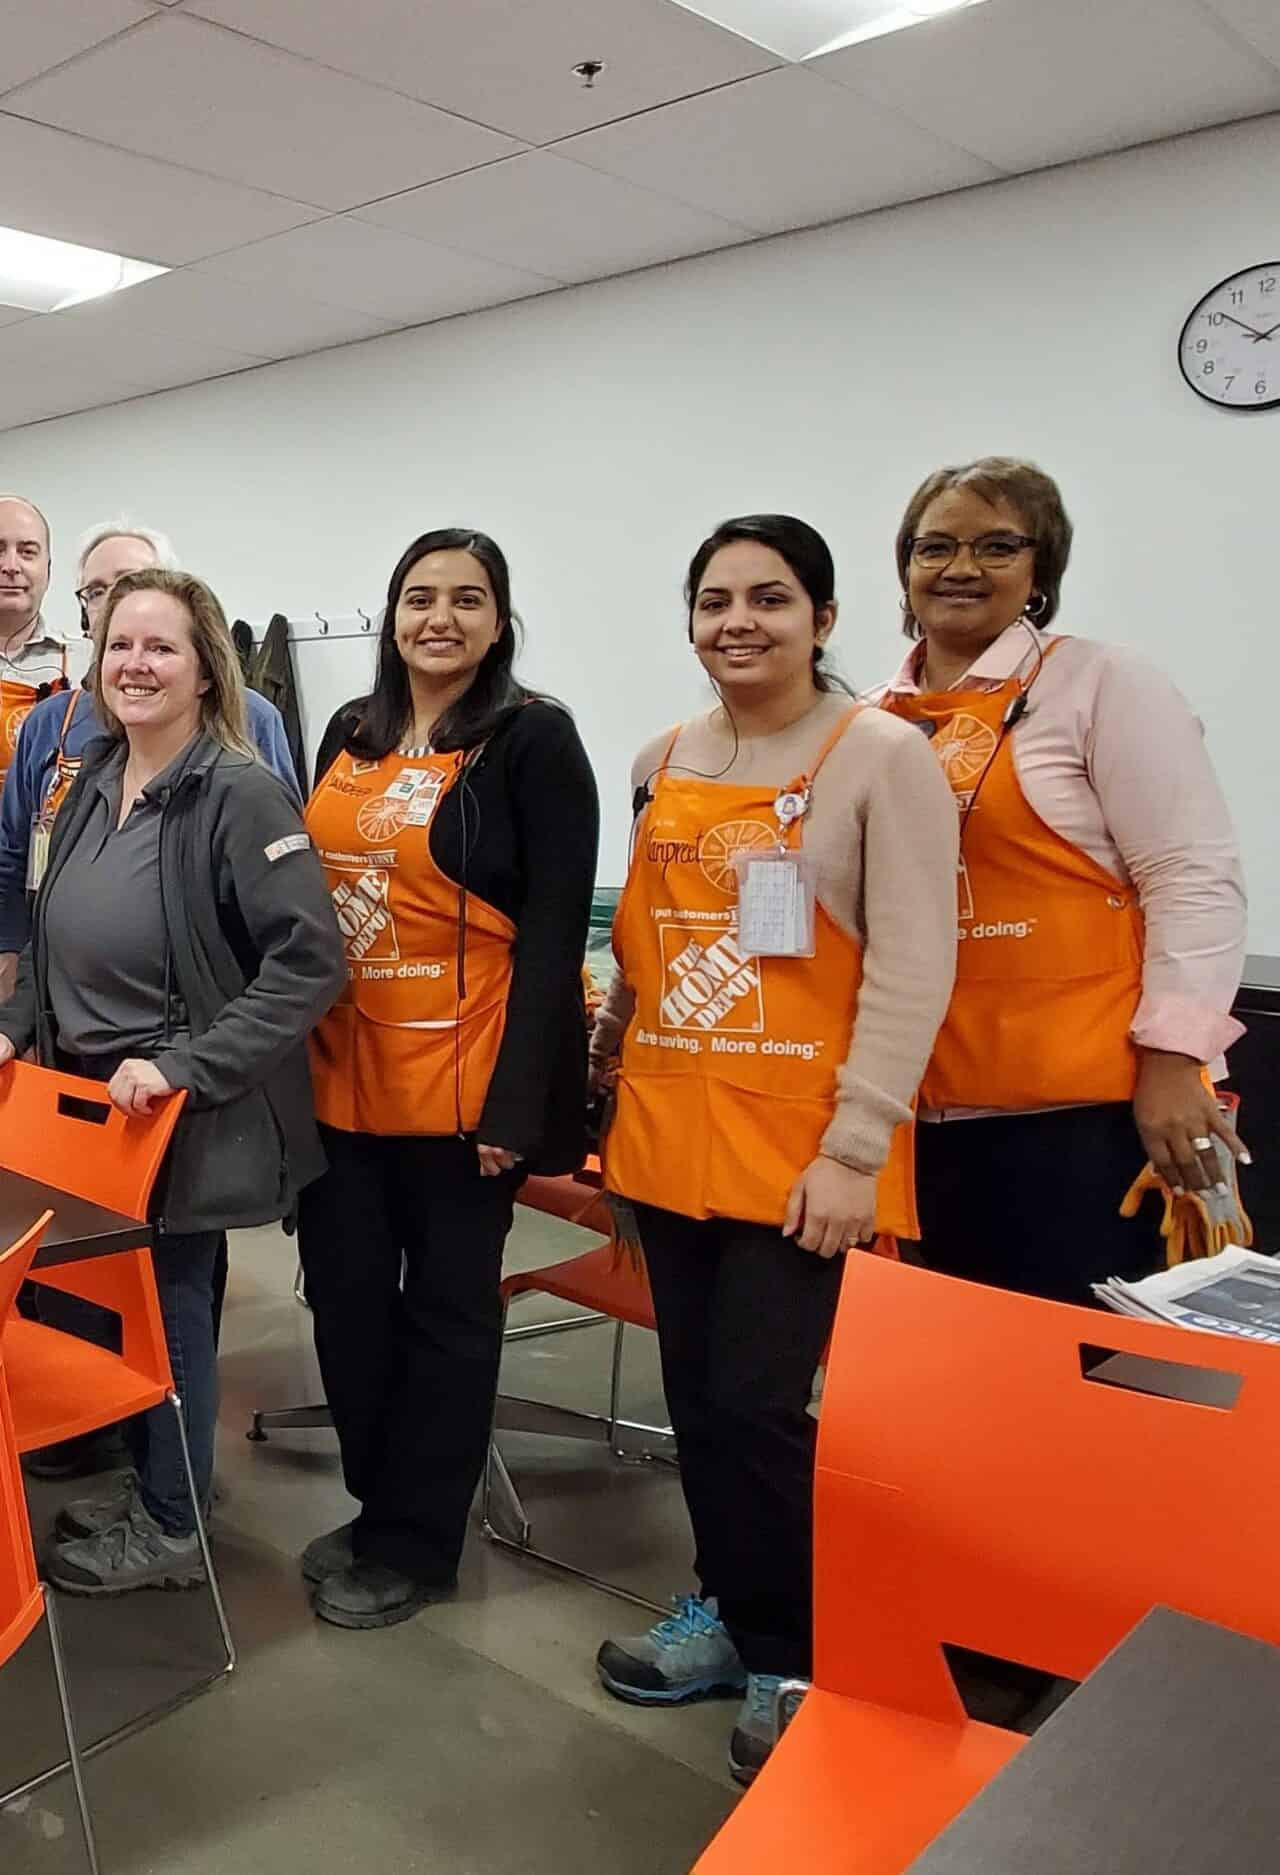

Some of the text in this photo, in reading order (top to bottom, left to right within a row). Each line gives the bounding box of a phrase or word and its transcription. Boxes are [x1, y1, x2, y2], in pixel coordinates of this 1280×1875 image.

[1258, 277, 1276, 294] 12
[1231, 289, 1244, 304] 11
[1207, 311, 1224, 327] 10
[1195, 338, 1208, 353] 9
[1203, 360, 1215, 375] 8
[1224, 375, 1235, 391] 7
[1254, 380, 1267, 394] 6
[361, 965, 395, 980] More
[694, 965, 760, 1030] DEPOT
[711, 1036, 757, 1052] More
